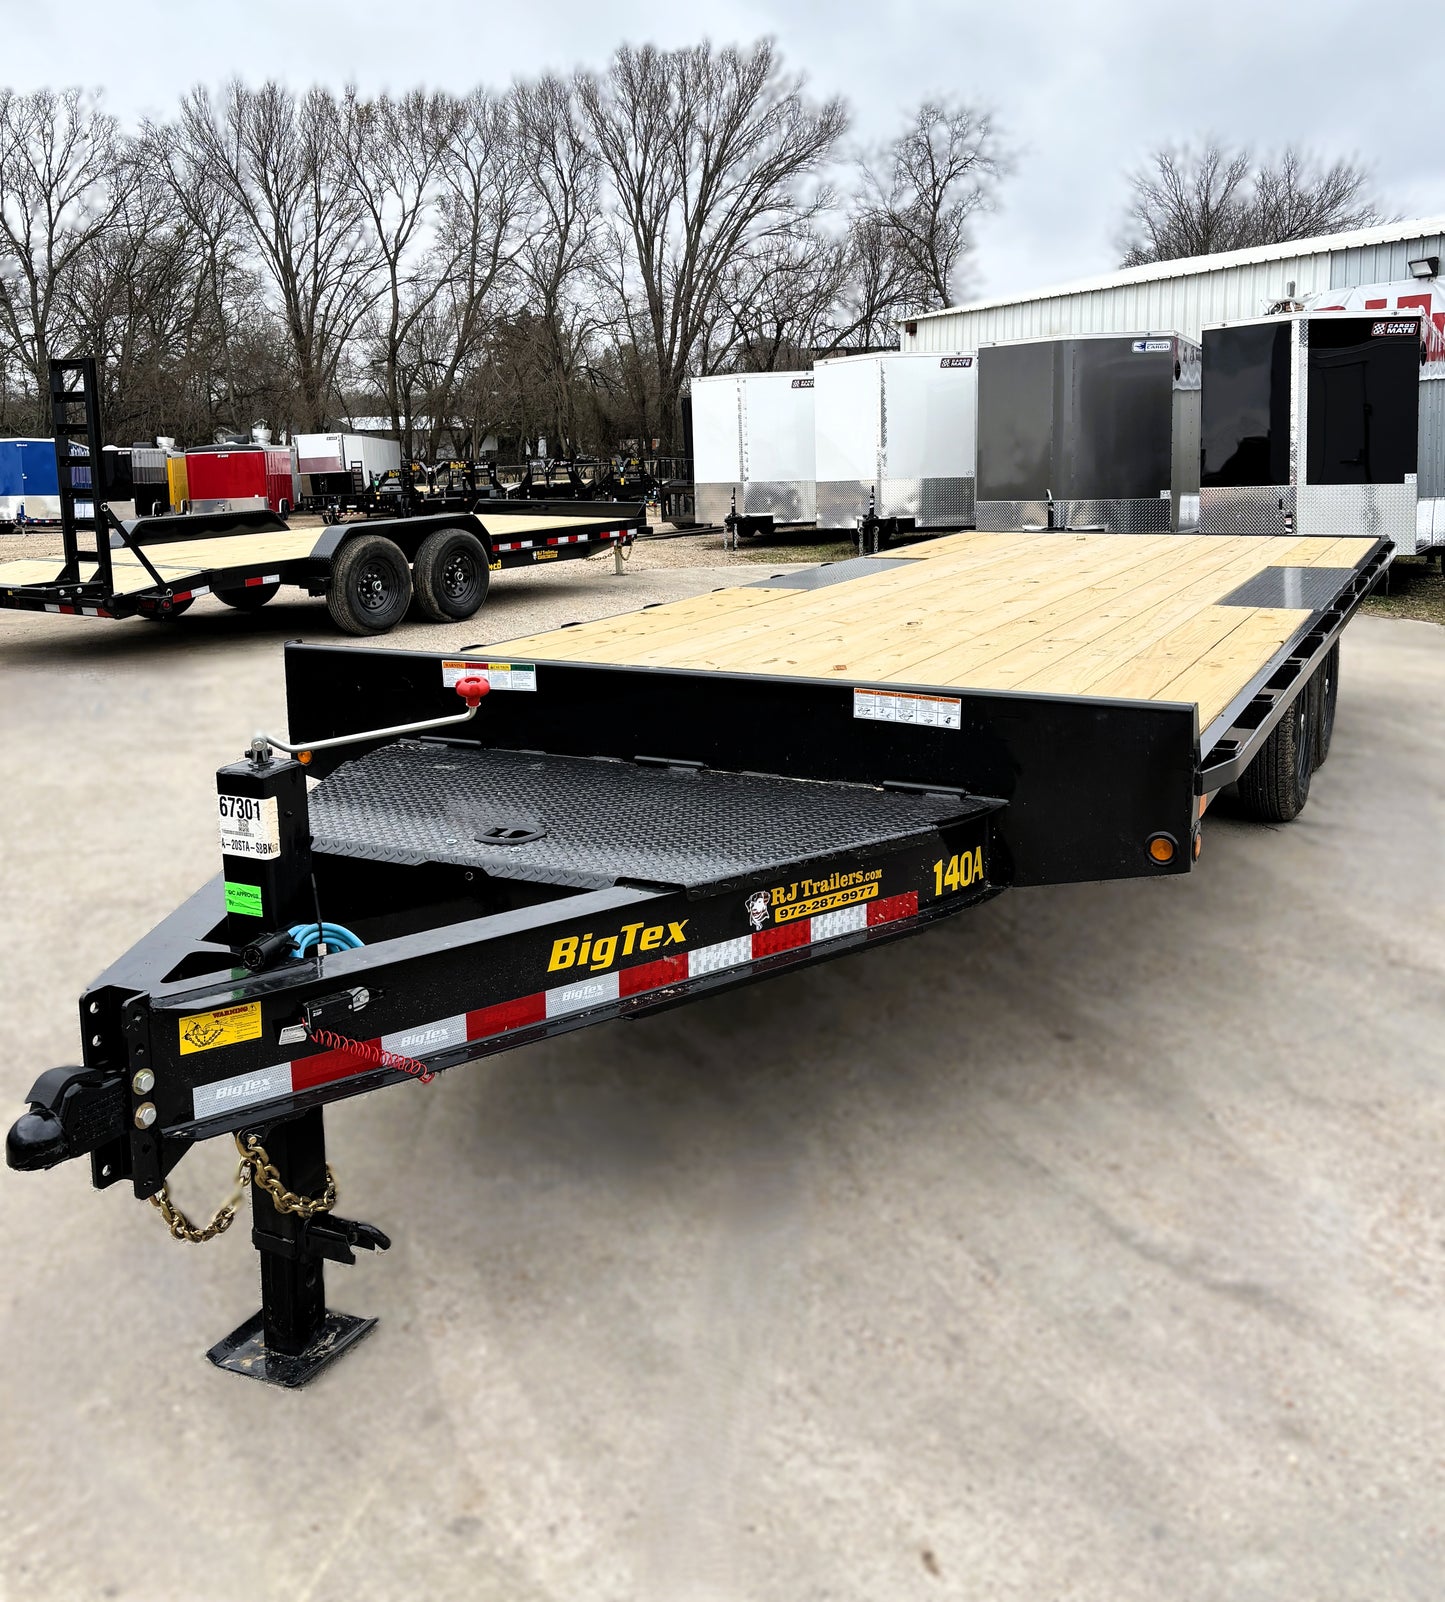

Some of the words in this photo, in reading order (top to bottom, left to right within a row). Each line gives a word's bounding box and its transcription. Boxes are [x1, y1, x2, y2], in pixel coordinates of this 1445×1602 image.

[219, 795, 261, 821] 67301
[933, 845, 984, 897] 140A
[770, 881, 798, 907] RJ
[779, 885, 875, 919] 972-287-9977
[547, 918, 690, 973] BigTex
[562, 983, 605, 1002] BigTex
[212, 1005, 249, 1019] WARNING
[400, 1027, 449, 1048] BigTex
[215, 1077, 272, 1100] BigTex
